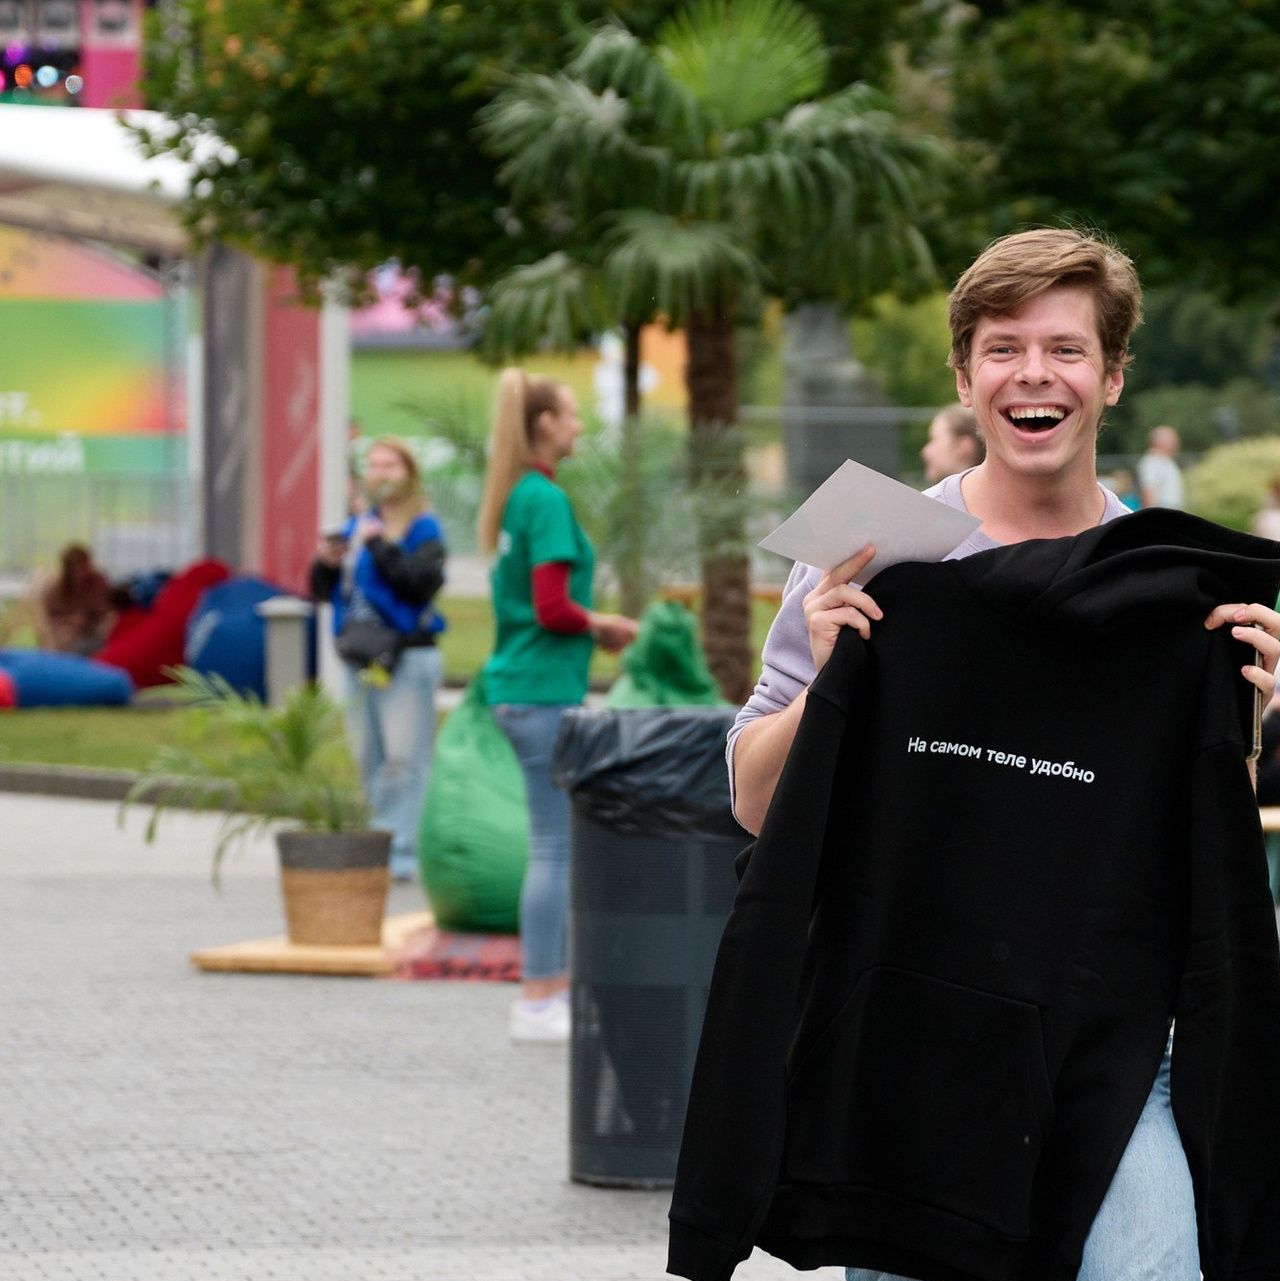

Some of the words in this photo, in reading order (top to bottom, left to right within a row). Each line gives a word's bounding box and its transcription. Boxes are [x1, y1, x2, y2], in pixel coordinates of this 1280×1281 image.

[907, 737, 927, 753] На
[929, 740, 982, 759] самом
[986, 749, 1027, 768] теле
[1029, 758, 1095, 783] удобно
